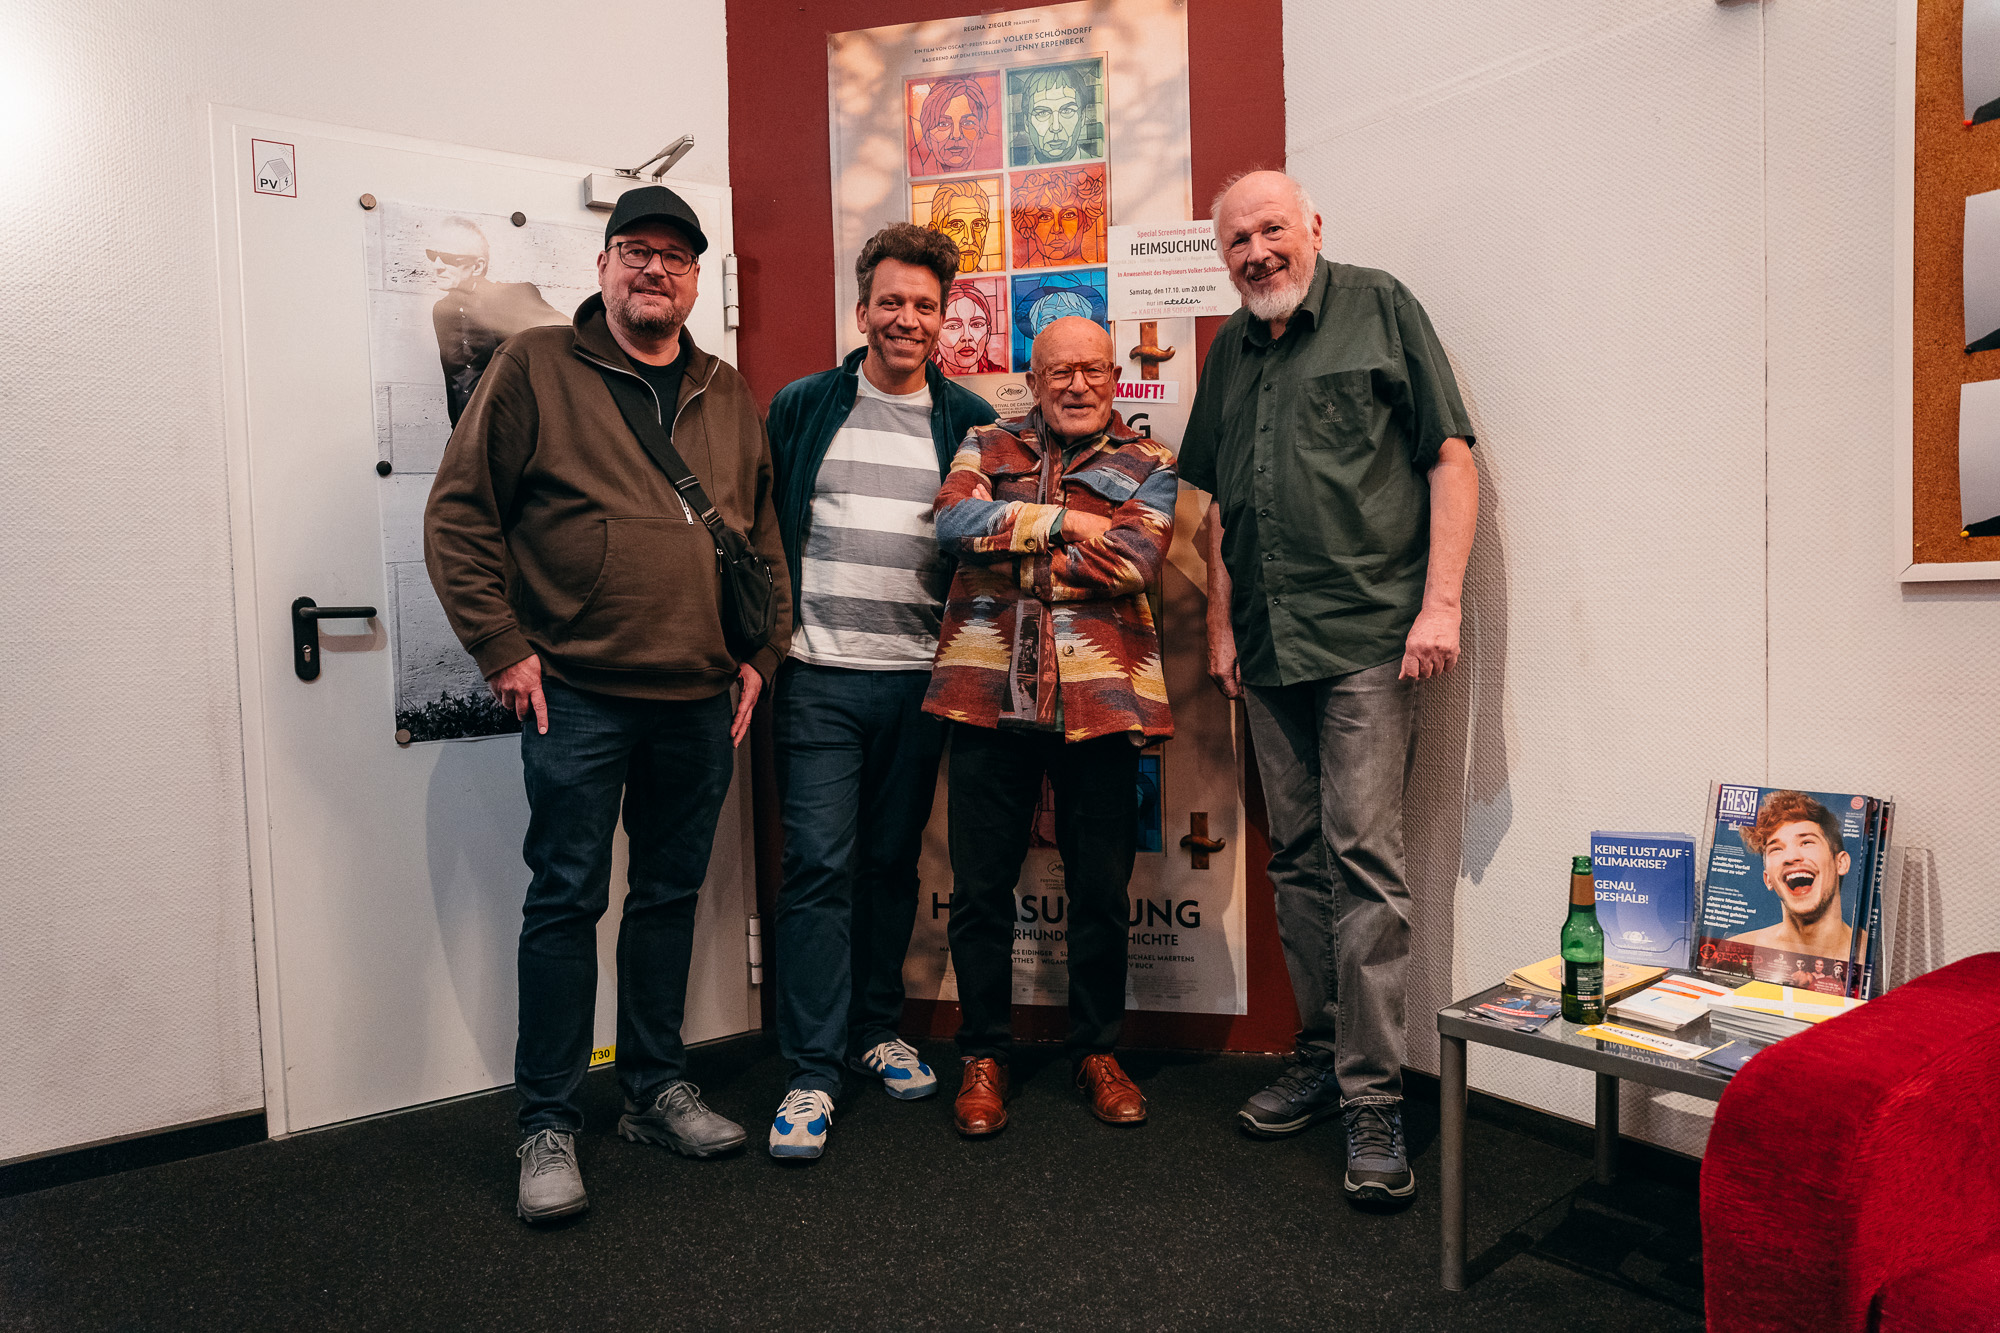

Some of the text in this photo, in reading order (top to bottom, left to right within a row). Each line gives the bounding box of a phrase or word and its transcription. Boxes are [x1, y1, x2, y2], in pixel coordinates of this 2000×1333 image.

[988, 21, 1012, 29] ZIEGLER
[1003, 33, 1033, 43] VOLKER
[1035, 26, 1092, 40] SCHLÖNDORFF
[1014, 42, 1039, 52] JENNY
[1041, 37, 1085, 49] ERPENBECK
[260, 178, 278, 189] PV
[1137, 230, 1157, 238] Special
[1158, 228, 1186, 237] Screening
[1162, 268, 1187, 276] Regisseurs
[1130, 288, 1152, 296] Samstag,
[1164, 298, 1201, 306] atelier
[1116, 383, 1165, 399] KAUFT!
[1720, 789, 1758, 813] FRESH
[1594, 844, 1682, 858] KEINE LUST AUF
[1594, 856, 1667, 869] KLIMAKRISE?
[1594, 880, 1636, 892] GENAU,
[1594, 892, 1648, 904] DESHALB!
